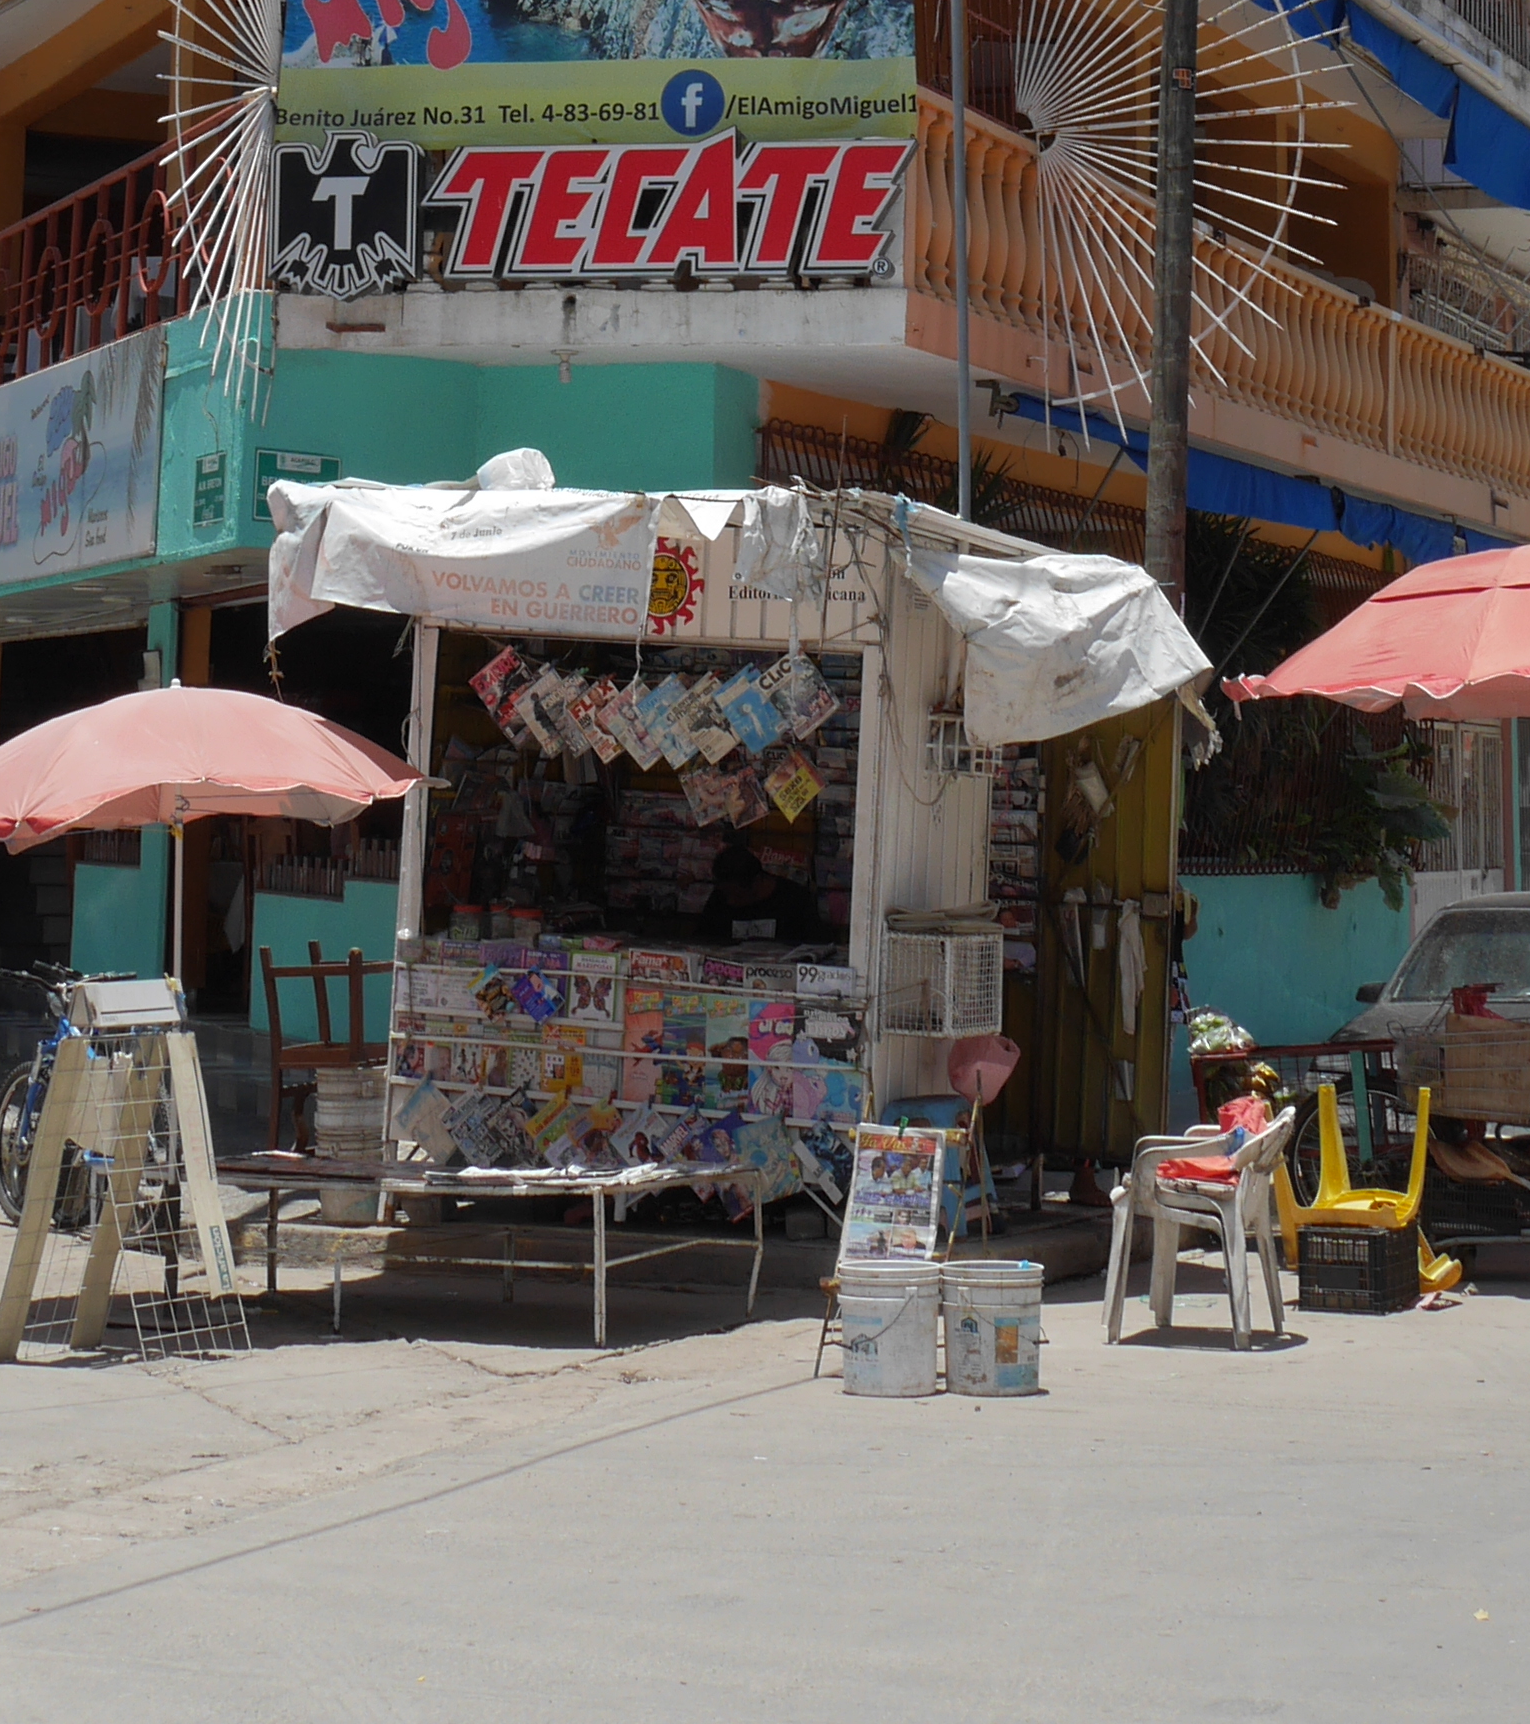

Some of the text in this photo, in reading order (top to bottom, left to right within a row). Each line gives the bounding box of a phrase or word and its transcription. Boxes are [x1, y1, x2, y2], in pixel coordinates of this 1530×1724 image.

[276, 101, 659, 127] Benito Juárez No.31 Tel. 4-83-69-81
[444, 133, 910, 267] TECATE
[450, 526, 502, 540] 7 de Junio
[567, 556, 641, 572] CIUDADANO
[569, 549, 640, 560] MOVIMIENTO
[432, 570, 639, 605] VOLVAMOS A CREER
[491, 598, 638, 626] EN GUERRERO
[746, 965, 793, 978] proceso
[660, 1125, 689, 1157] MARVEL
